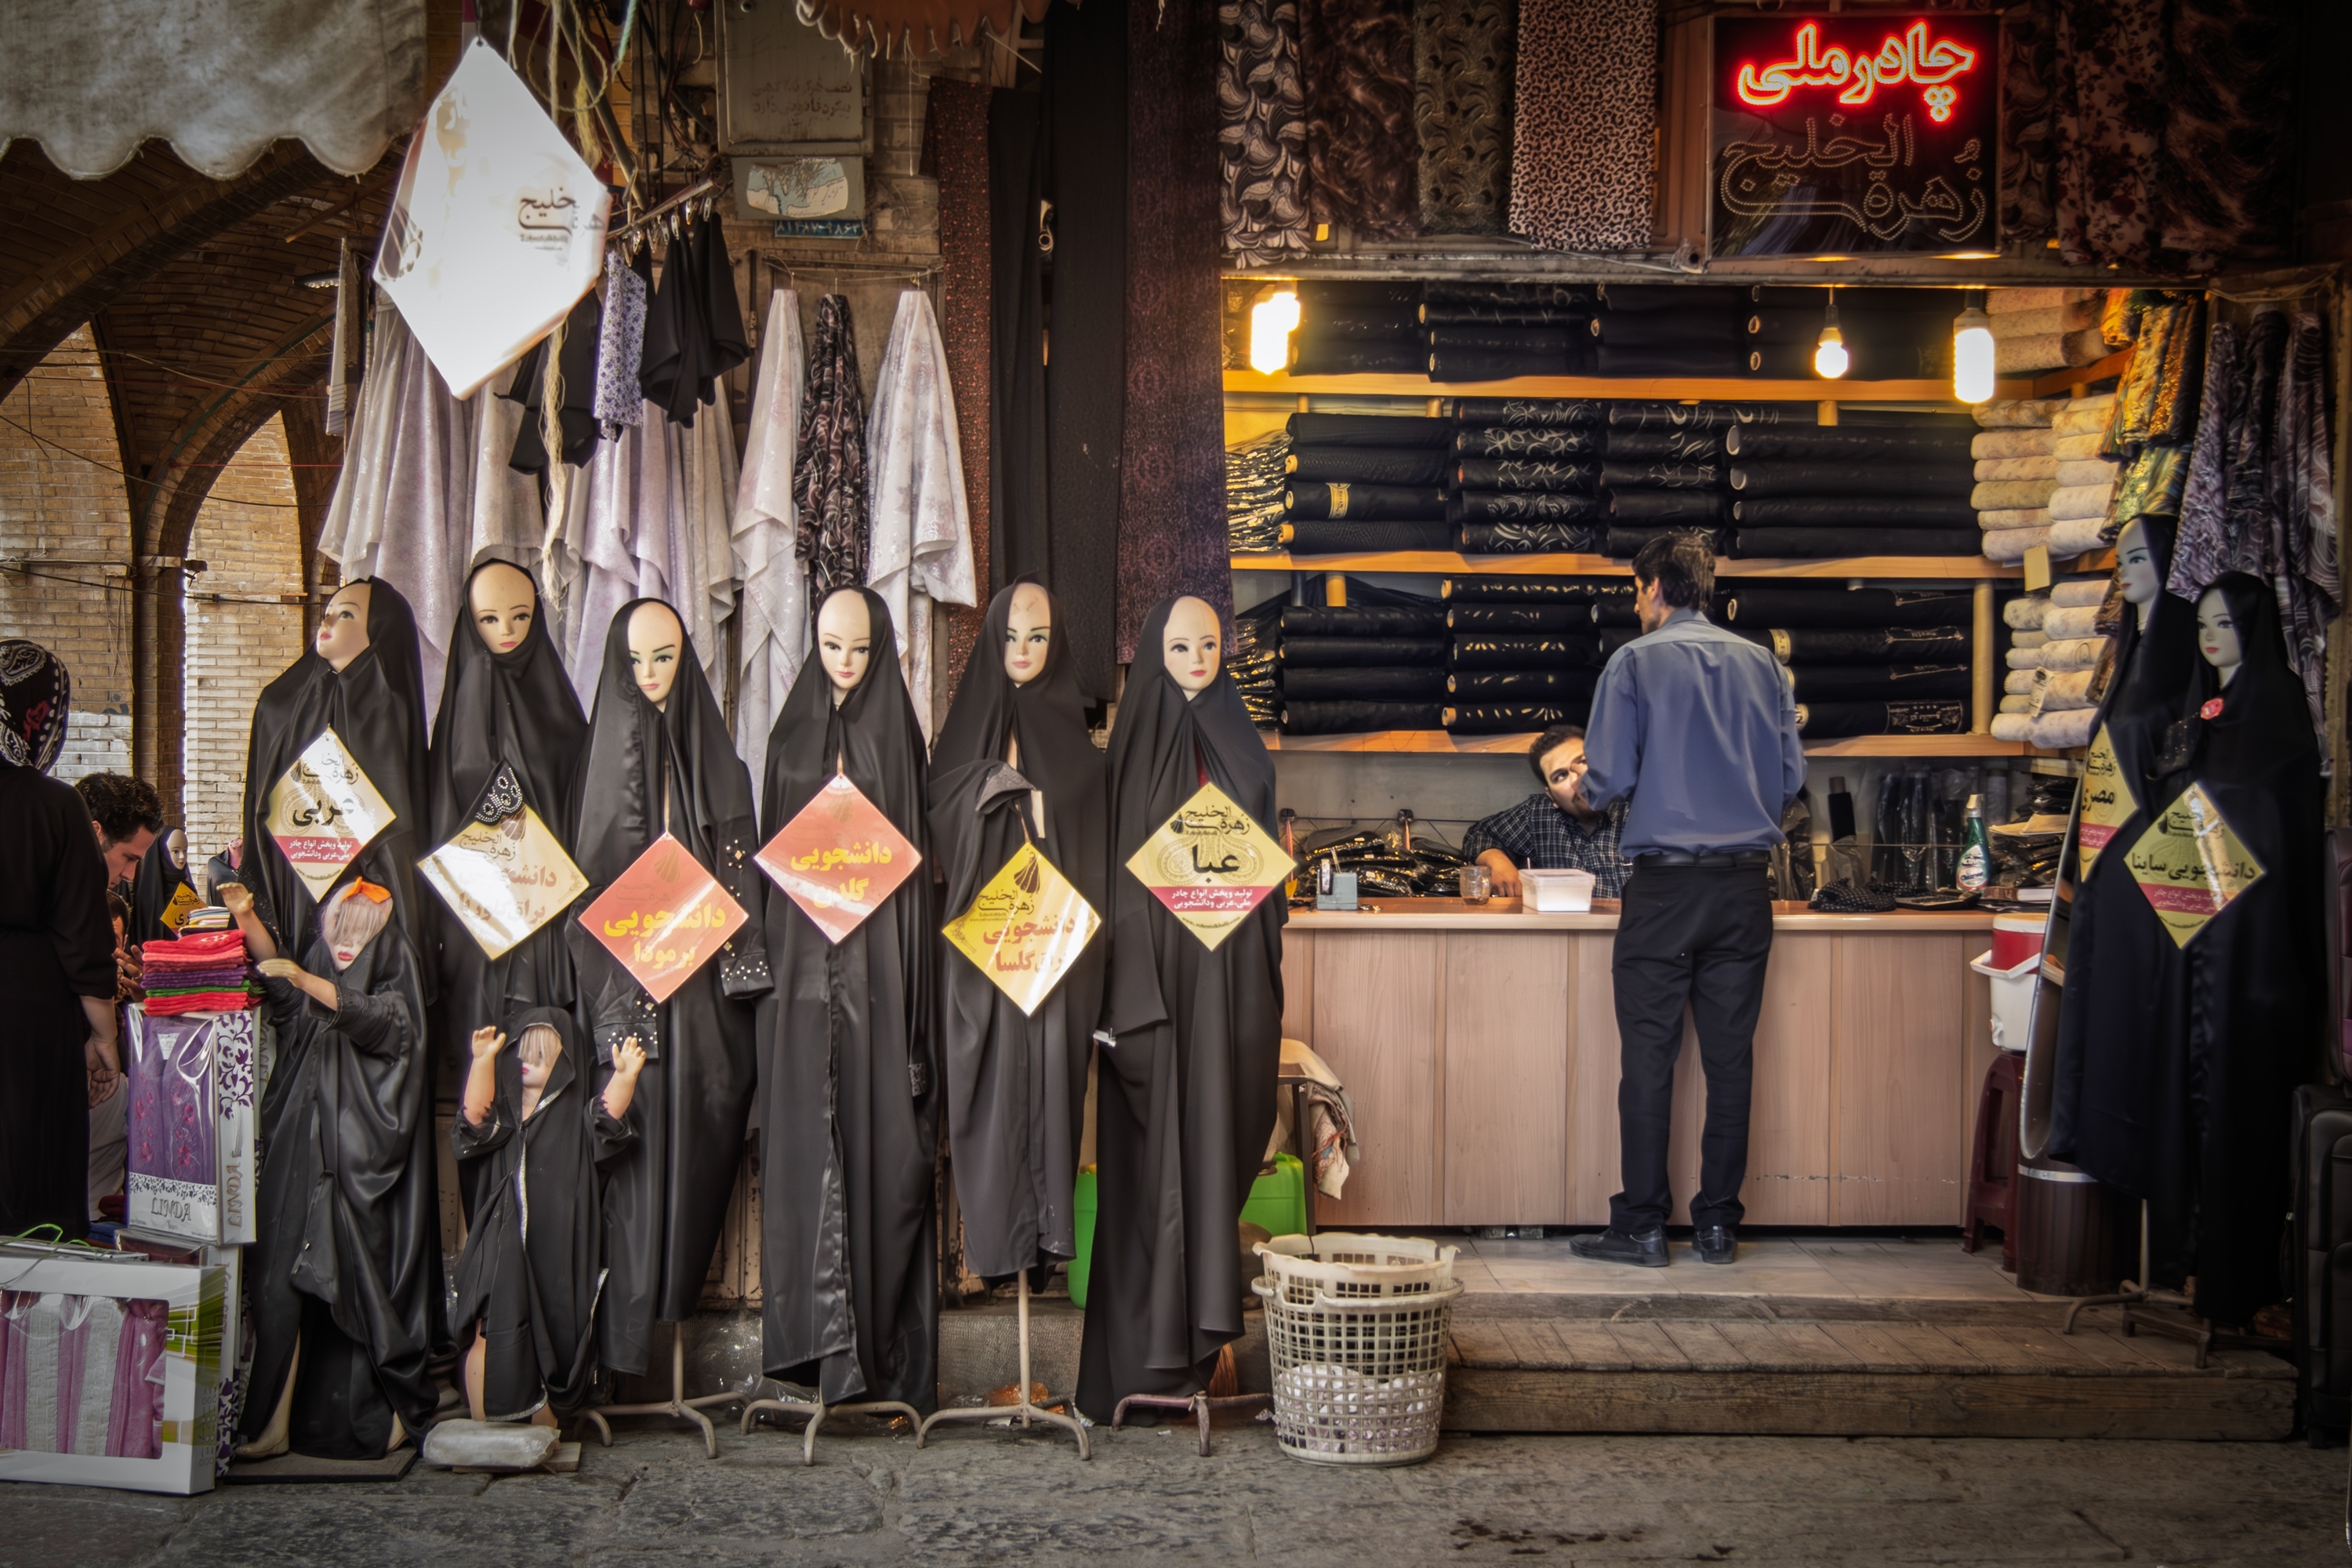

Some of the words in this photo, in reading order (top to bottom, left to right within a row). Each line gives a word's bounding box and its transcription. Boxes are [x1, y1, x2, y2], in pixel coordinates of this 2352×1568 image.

[790, 841, 892, 871] دانشجویی
[1192, 844, 1240, 884] عبا
[1190, 888, 1208, 899] انواع
[1234, 888, 1253, 898] تولید
[983, 914, 1076, 945] دانشجویی
[151, 1196, 192, 1222] LINDA
[226, 1162, 242, 1228] LINDA
